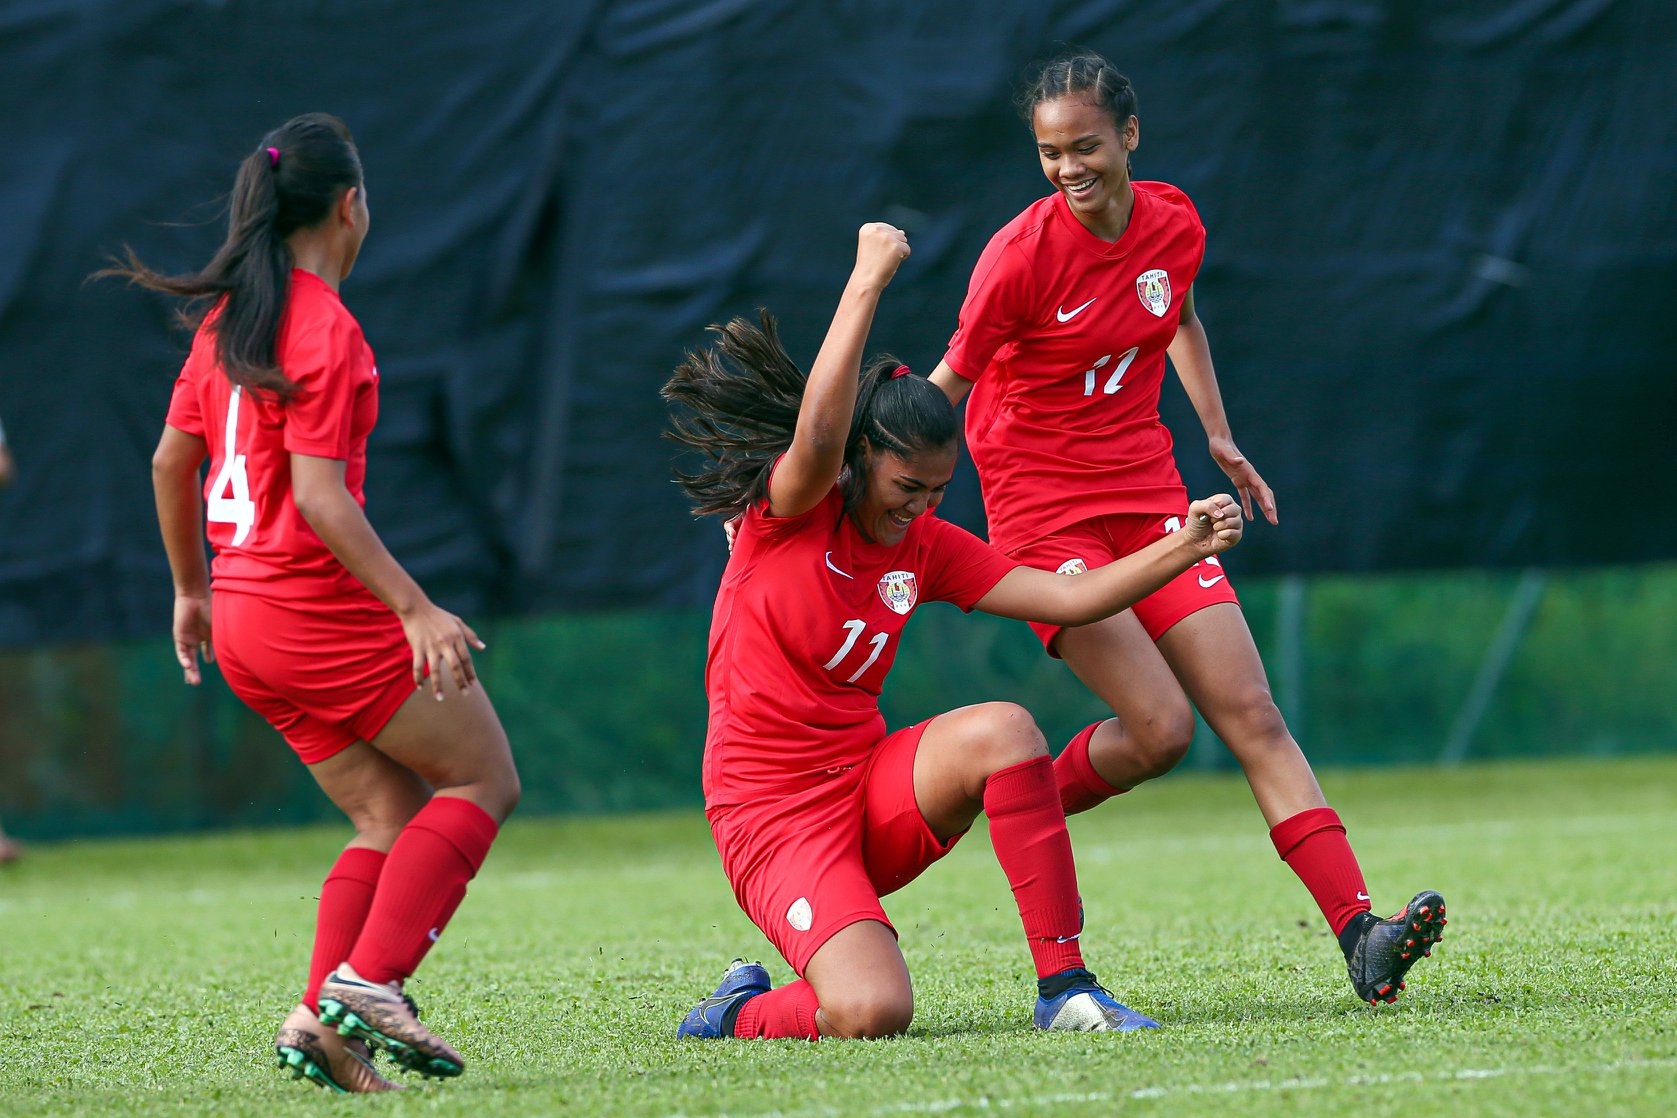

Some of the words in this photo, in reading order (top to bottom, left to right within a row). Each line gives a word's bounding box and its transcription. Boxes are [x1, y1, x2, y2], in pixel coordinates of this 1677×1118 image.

[1141, 271, 1163, 281] TAHITI
[207, 384, 256, 547] 4
[882, 573, 909, 581] TAHITI
[822, 619, 889, 683] 11
